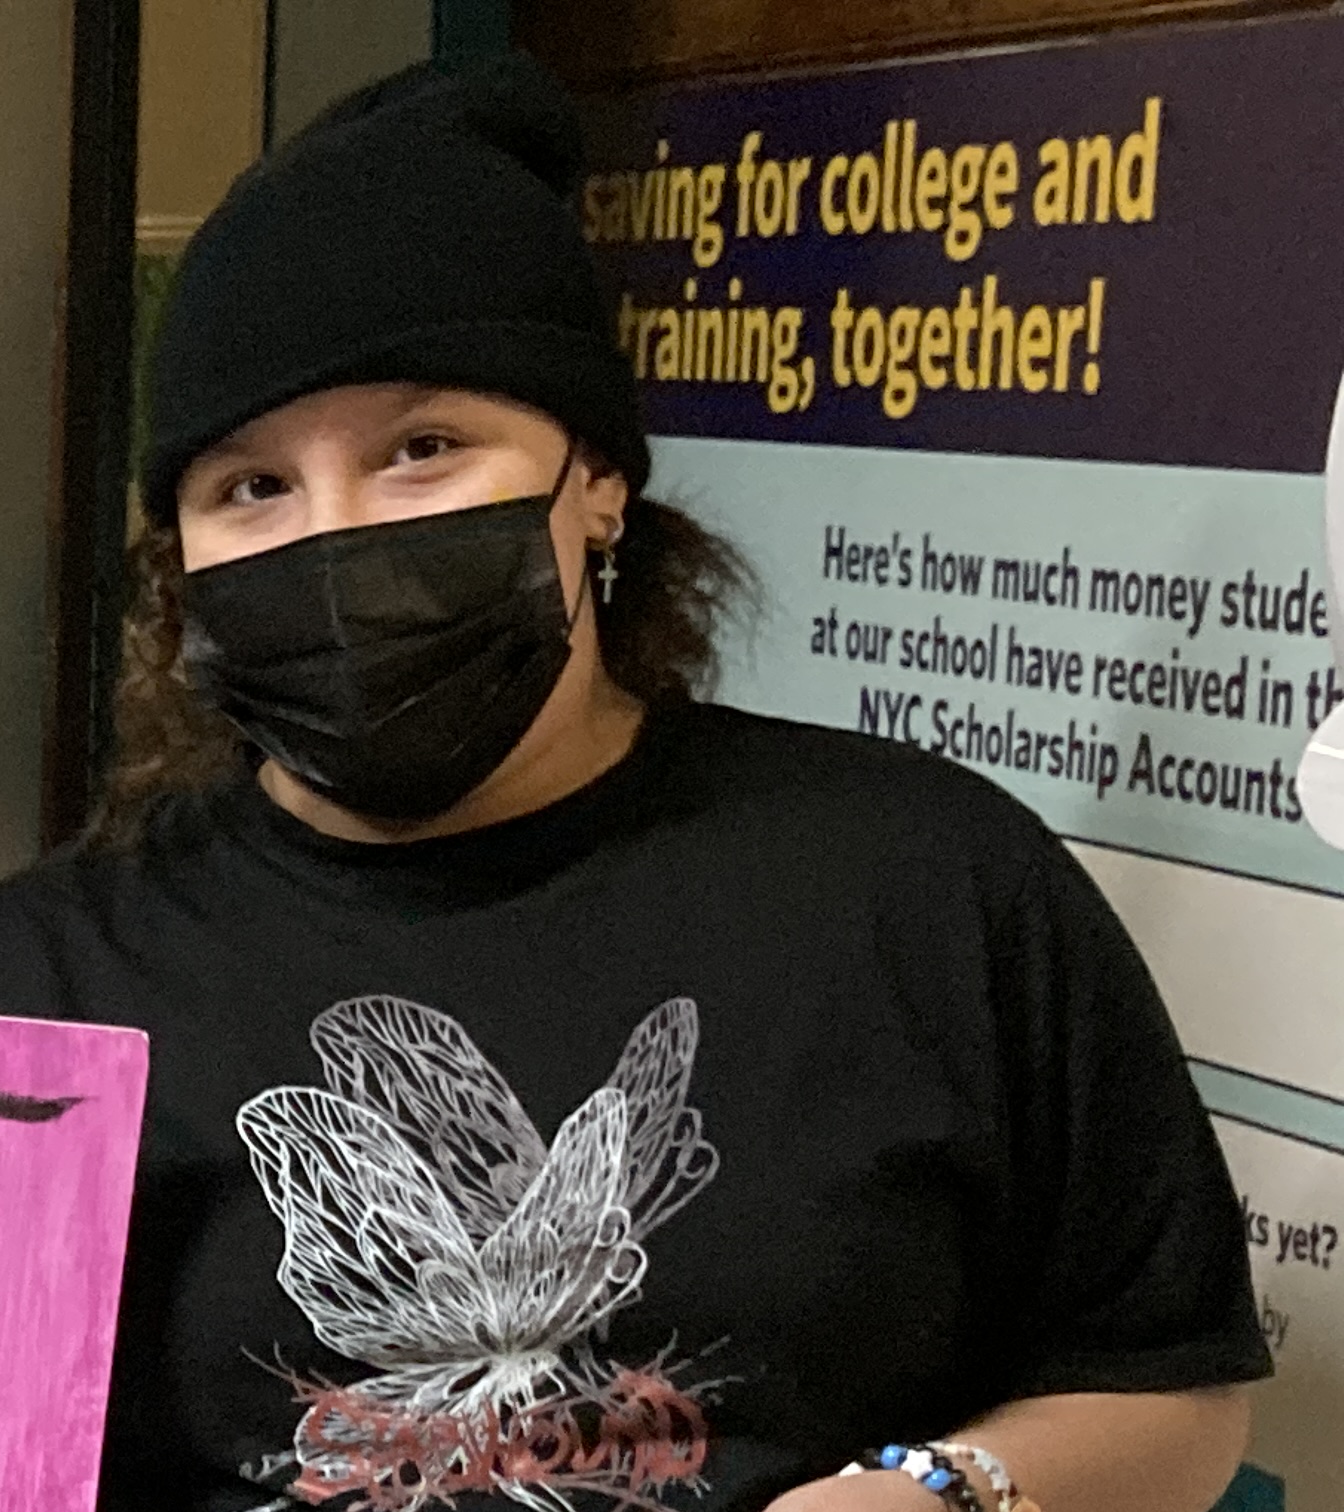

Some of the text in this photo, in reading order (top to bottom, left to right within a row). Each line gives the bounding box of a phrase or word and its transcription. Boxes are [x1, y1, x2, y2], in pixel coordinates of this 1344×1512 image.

[581, 95, 1163, 268] saving for college and
[618, 274, 1108, 420] training, together!
[823, 524, 912, 588] Here's
[921, 532, 985, 598] how
[992, 547, 1079, 611] much
[1089, 566, 1211, 637] money
[810, 608, 839, 656] at
[845, 625, 892, 666] our
[899, 616, 999, 684] school
[1006, 626, 1083, 697] have
[1092, 648, 1249, 722] received
[1258, 663, 1293, 730] in
[859, 685, 1305, 824] NYC Scholarship Accounts
[1275, 1221, 1339, 1271] yet?
